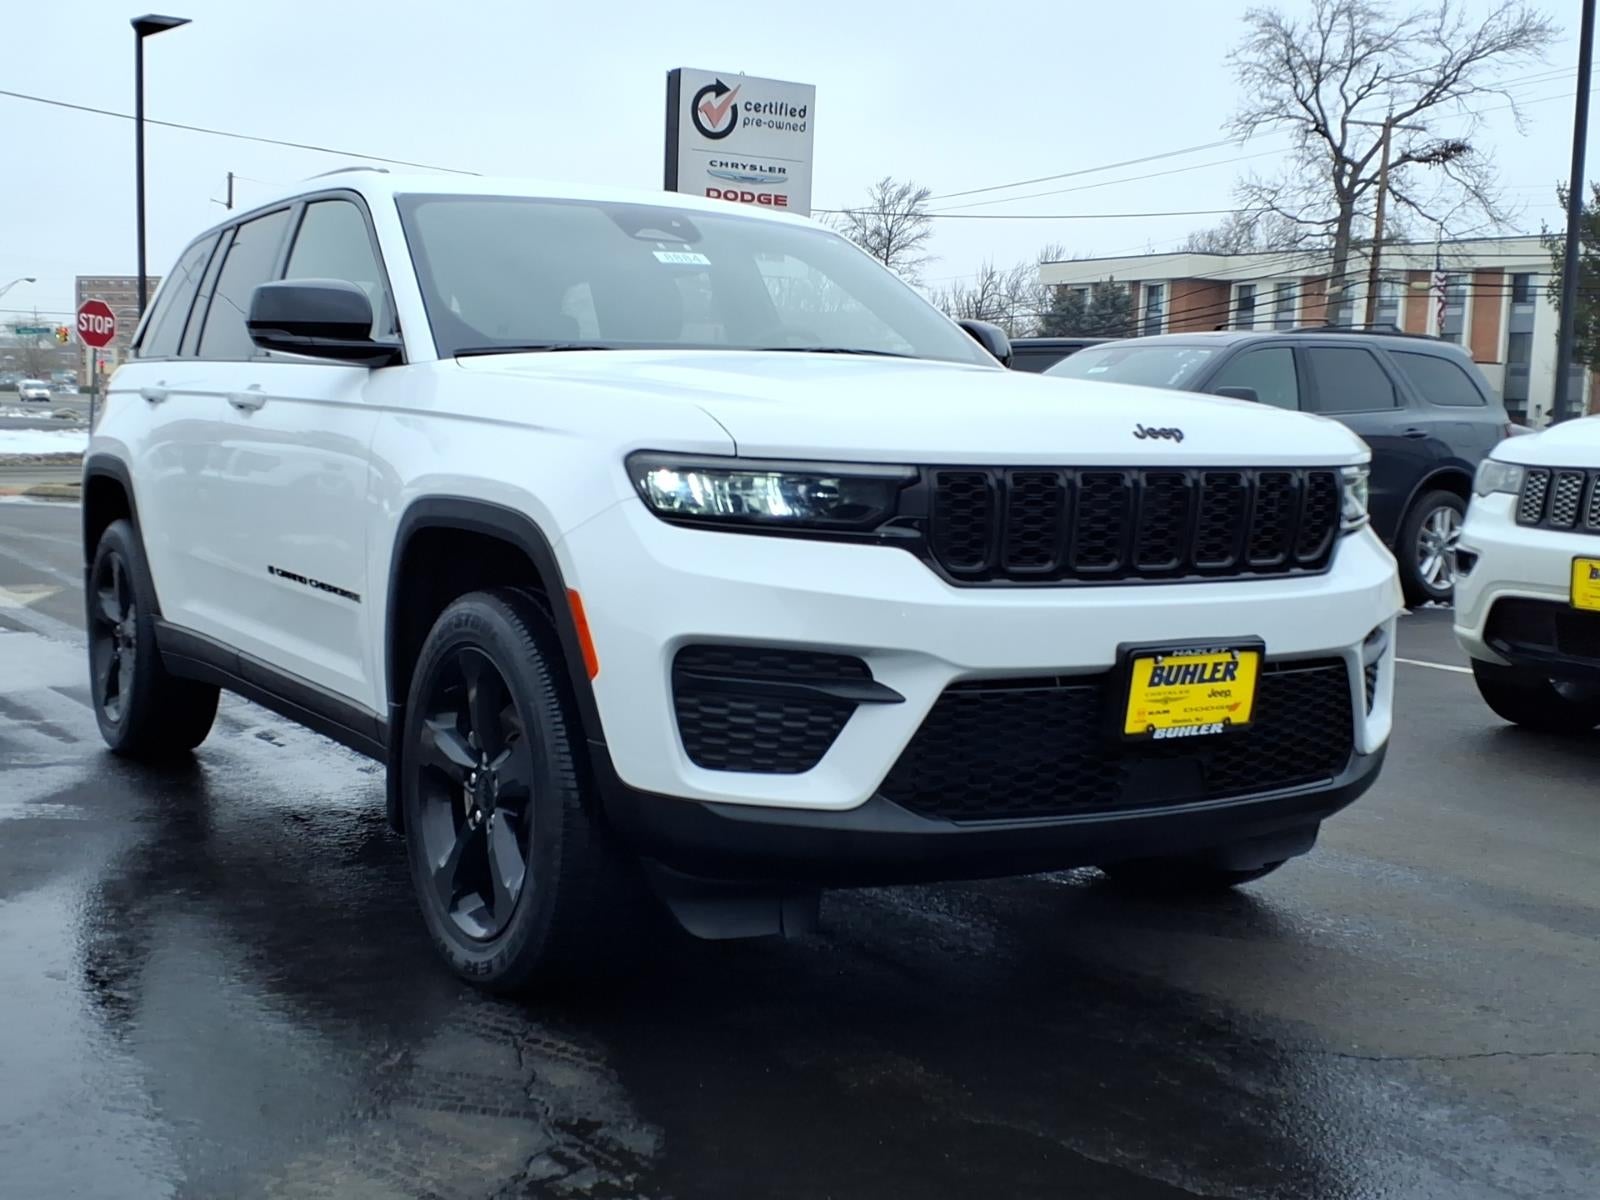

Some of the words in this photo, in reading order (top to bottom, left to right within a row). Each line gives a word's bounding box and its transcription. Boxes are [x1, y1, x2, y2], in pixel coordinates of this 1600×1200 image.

[744, 101, 807, 118] certified
[743, 117, 807, 133] pre-owned
[709, 160, 787, 174] CHRYSLER
[706, 188, 788, 207] DODGE
[79, 313, 114, 334] STOP
[1132, 423, 1184, 443] Jeep
[1148, 661, 1239, 688] BUHLER
[1153, 723, 1225, 739] BUHLER
